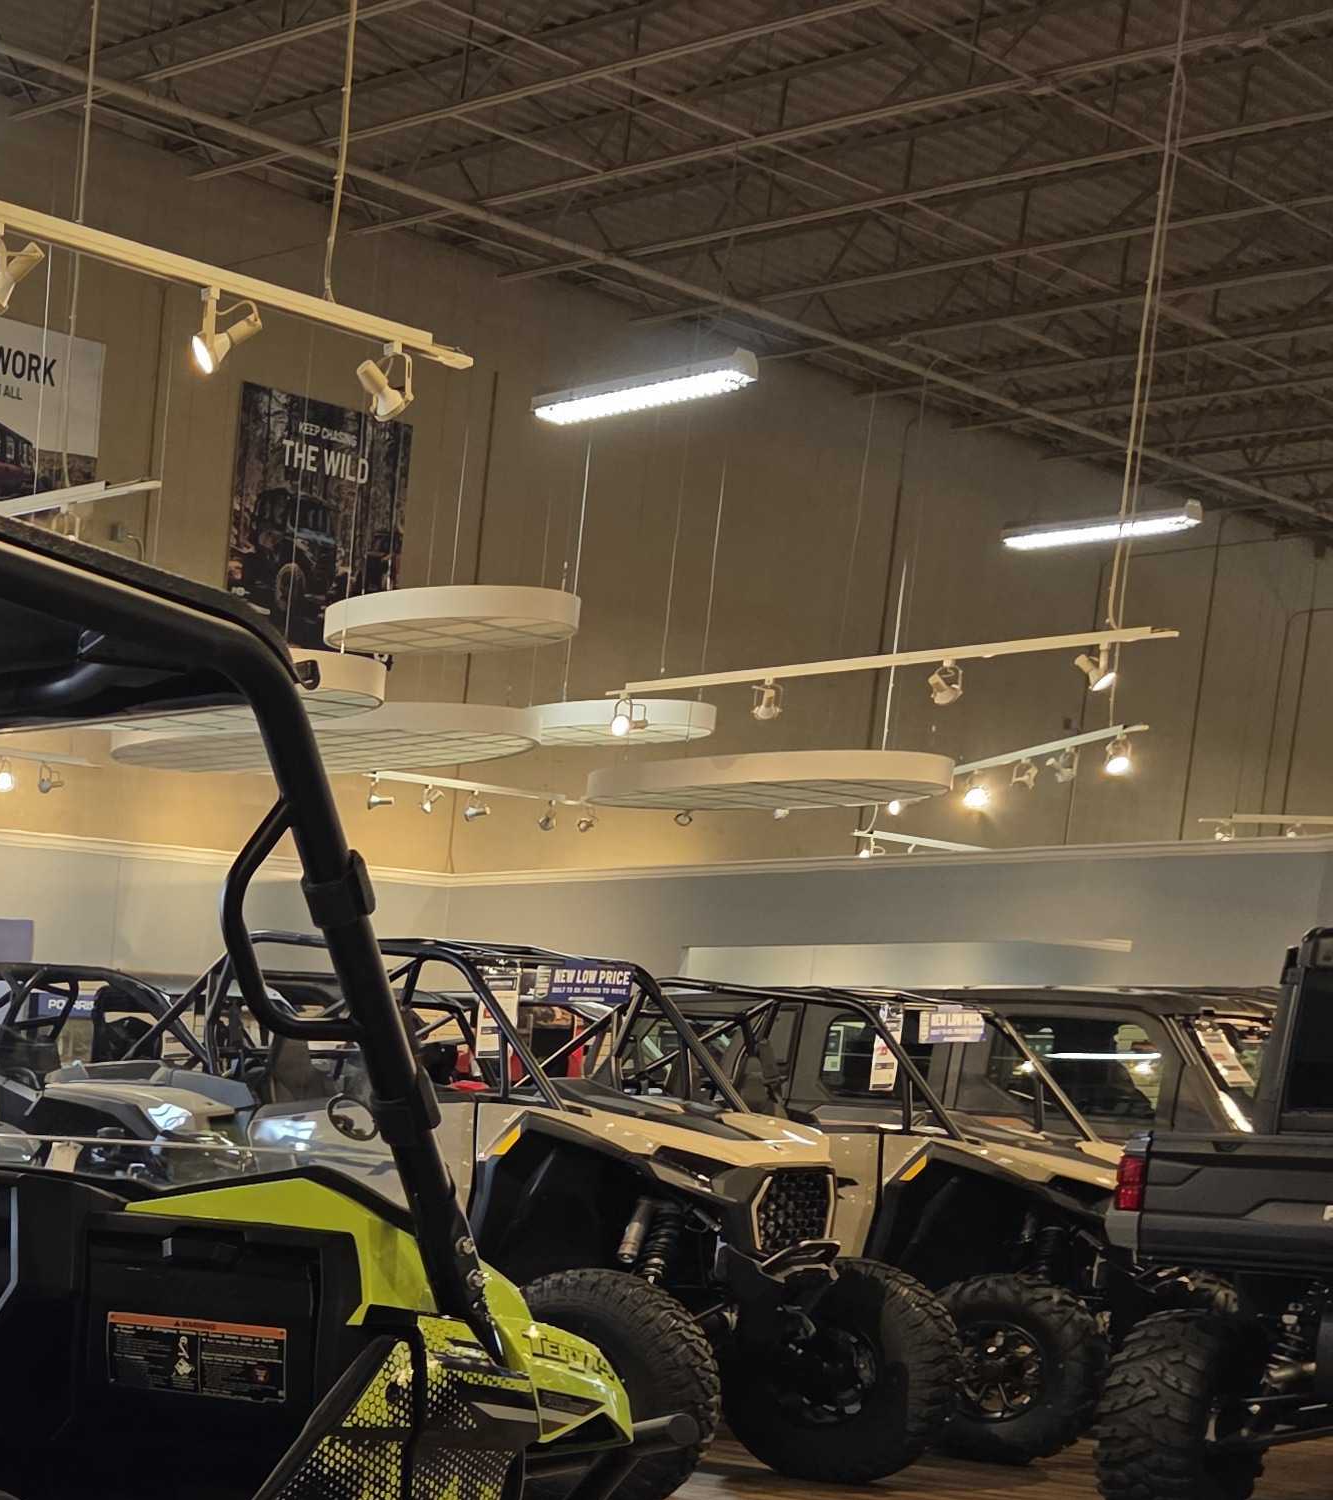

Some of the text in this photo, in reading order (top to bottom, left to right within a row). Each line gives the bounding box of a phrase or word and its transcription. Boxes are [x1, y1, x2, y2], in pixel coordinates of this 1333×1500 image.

[3, 385, 23, 400] ALL
[299, 422, 321, 437] KEEP
[282, 439, 369, 483] THE WILD
[553, 968, 576, 984] NEW
[576, 968, 598, 984] LOW
[598, 969, 631, 986] PRICE
